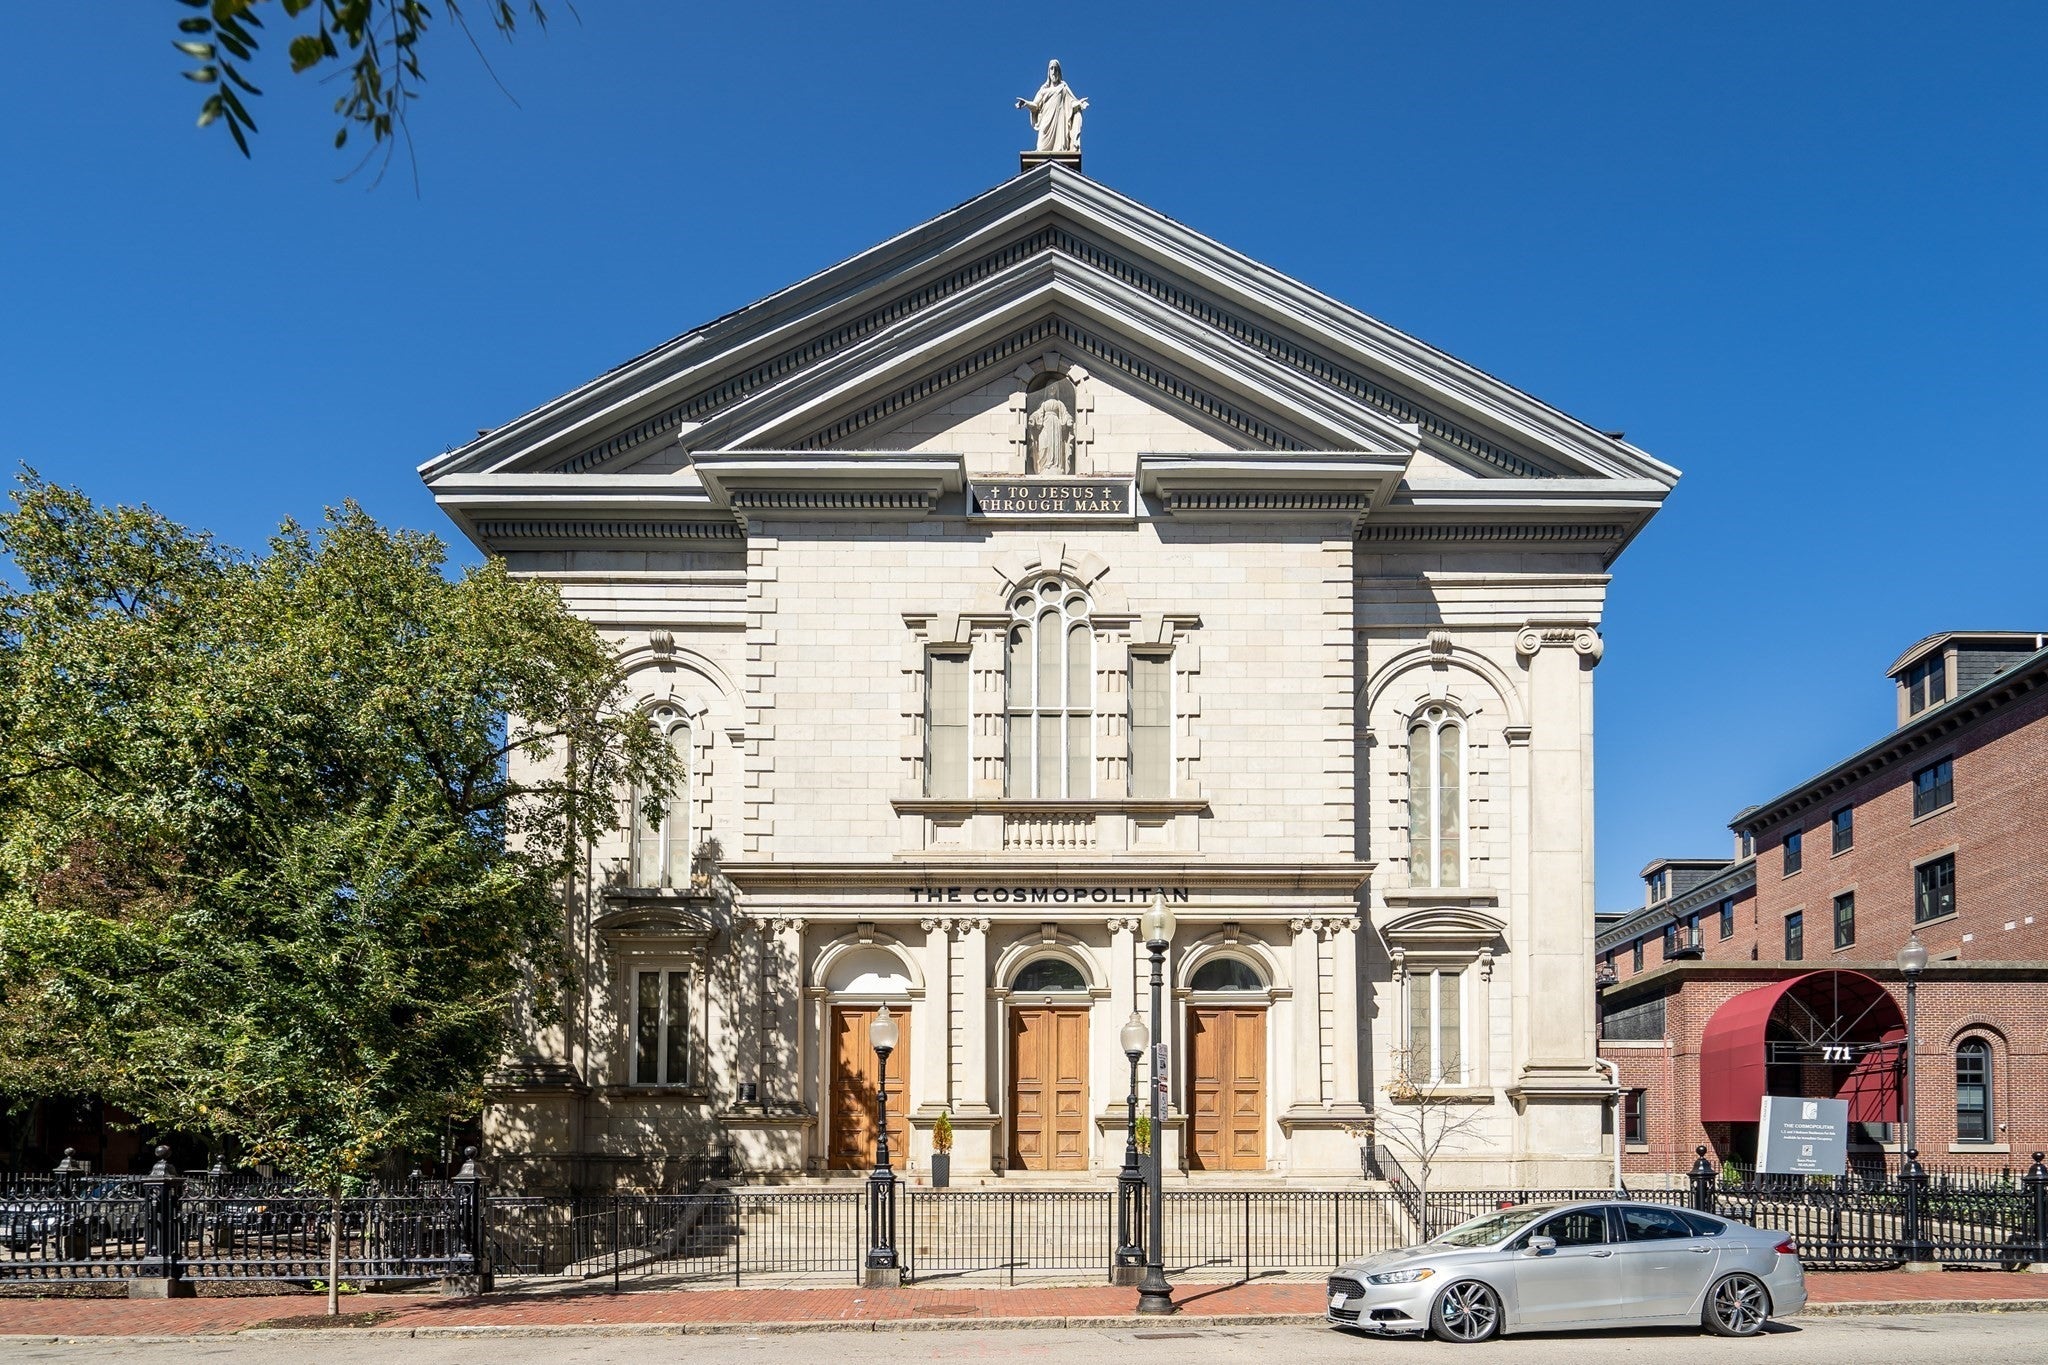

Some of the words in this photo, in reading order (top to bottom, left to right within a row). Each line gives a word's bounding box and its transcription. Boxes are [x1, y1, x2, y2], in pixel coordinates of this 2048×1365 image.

[1008, 487, 1029, 498] TO
[1038, 487, 1095, 499] JESUS
[979, 500, 1064, 511] THROUGH
[1075, 500, 1123, 511] MARY
[909, 887, 962, 902] THE
[1822, 1046, 1851, 1060] 771
